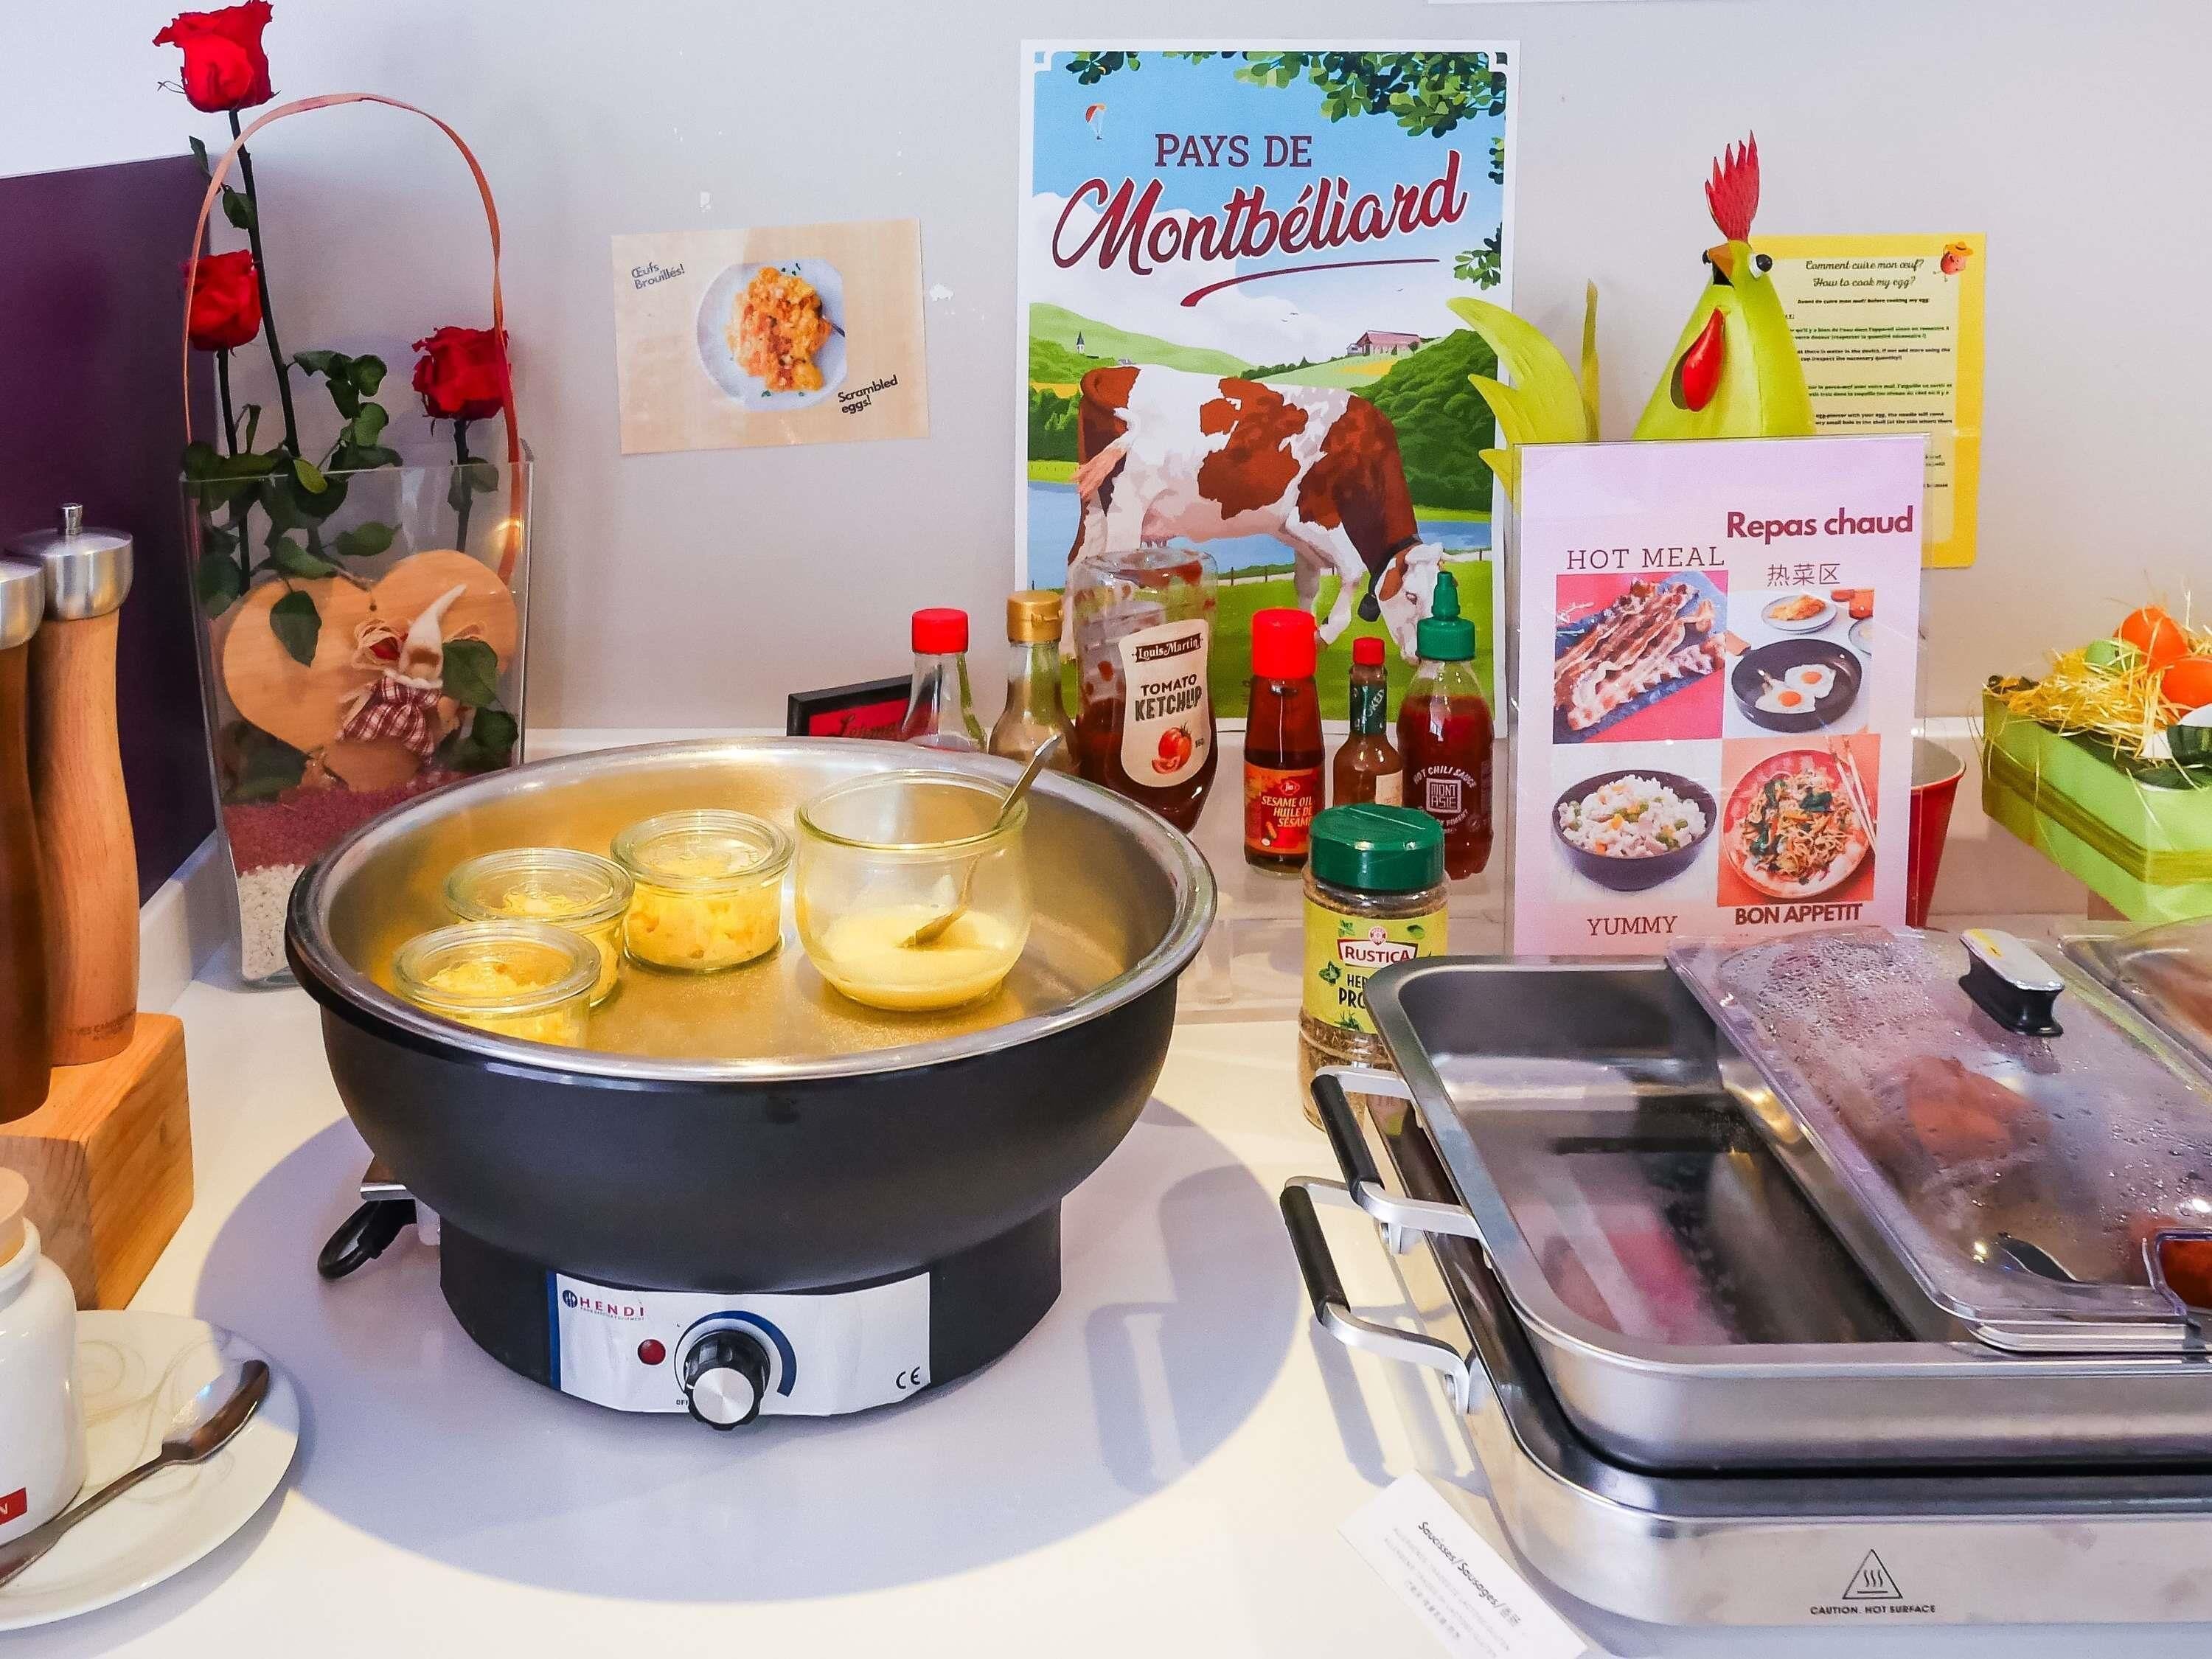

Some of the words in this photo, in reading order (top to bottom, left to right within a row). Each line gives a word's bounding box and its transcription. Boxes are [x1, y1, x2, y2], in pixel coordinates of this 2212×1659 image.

[1155, 133, 1250, 167] PAYS
[1263, 135, 1312, 167] DE
[1051, 149, 1469, 275] Montbéliard
[630, 261, 661, 279] Œufs
[634, 262, 686, 290] Brouillés!
[1806, 260, 1849, 270] Comment
[1851, 260, 1876, 270] cuire
[1899, 258, 1924, 271] œuf?
[1813, 277, 1837, 287] How
[1840, 278, 1849, 287] to
[1851, 277, 1874, 287] cook
[1875, 279, 1891, 290] my
[1892, 275, 1916, 289] egg?
[837, 374, 899, 403] Scrambled
[841, 394, 872, 415] eggs!
[1727, 511, 1818, 544] Repas
[1824, 505, 1913, 537] chaud
[1567, 549, 1630, 570] HOT
[1641, 546, 1725, 568] MEAL
[1767, 563, 1842, 587] 热菜区
[1137, 644, 1164, 661] Louis
[1164, 637, 1200, 656] Martin
[1141, 673, 1197, 697] TOMATO
[1135, 685, 1203, 721] KETCHUP
[1413, 768, 1427, 785] HOT
[1427, 765, 1454, 776] CHILI
[1453, 768, 1477, 788] SAUCE
[1262, 795, 1297, 807] SESAME
[1298, 796, 1313, 807] OIL
[1430, 783, 1456, 796] MONT
[1273, 807, 1301, 818] HUILE
[1430, 796, 1456, 809] ASIE
[1735, 908, 1783, 925] BON
[1784, 902, 1863, 923] APPETIT
[1587, 915, 1678, 936] YUMMY
[1345, 945, 1411, 963] RUSTICA
[580, 1296, 644, 1317] HENDI
[896, 1366, 921, 1389] CE
[1864, 1605, 1886, 1614] HOT
[1888, 1604, 1935, 1614] SURFACE
